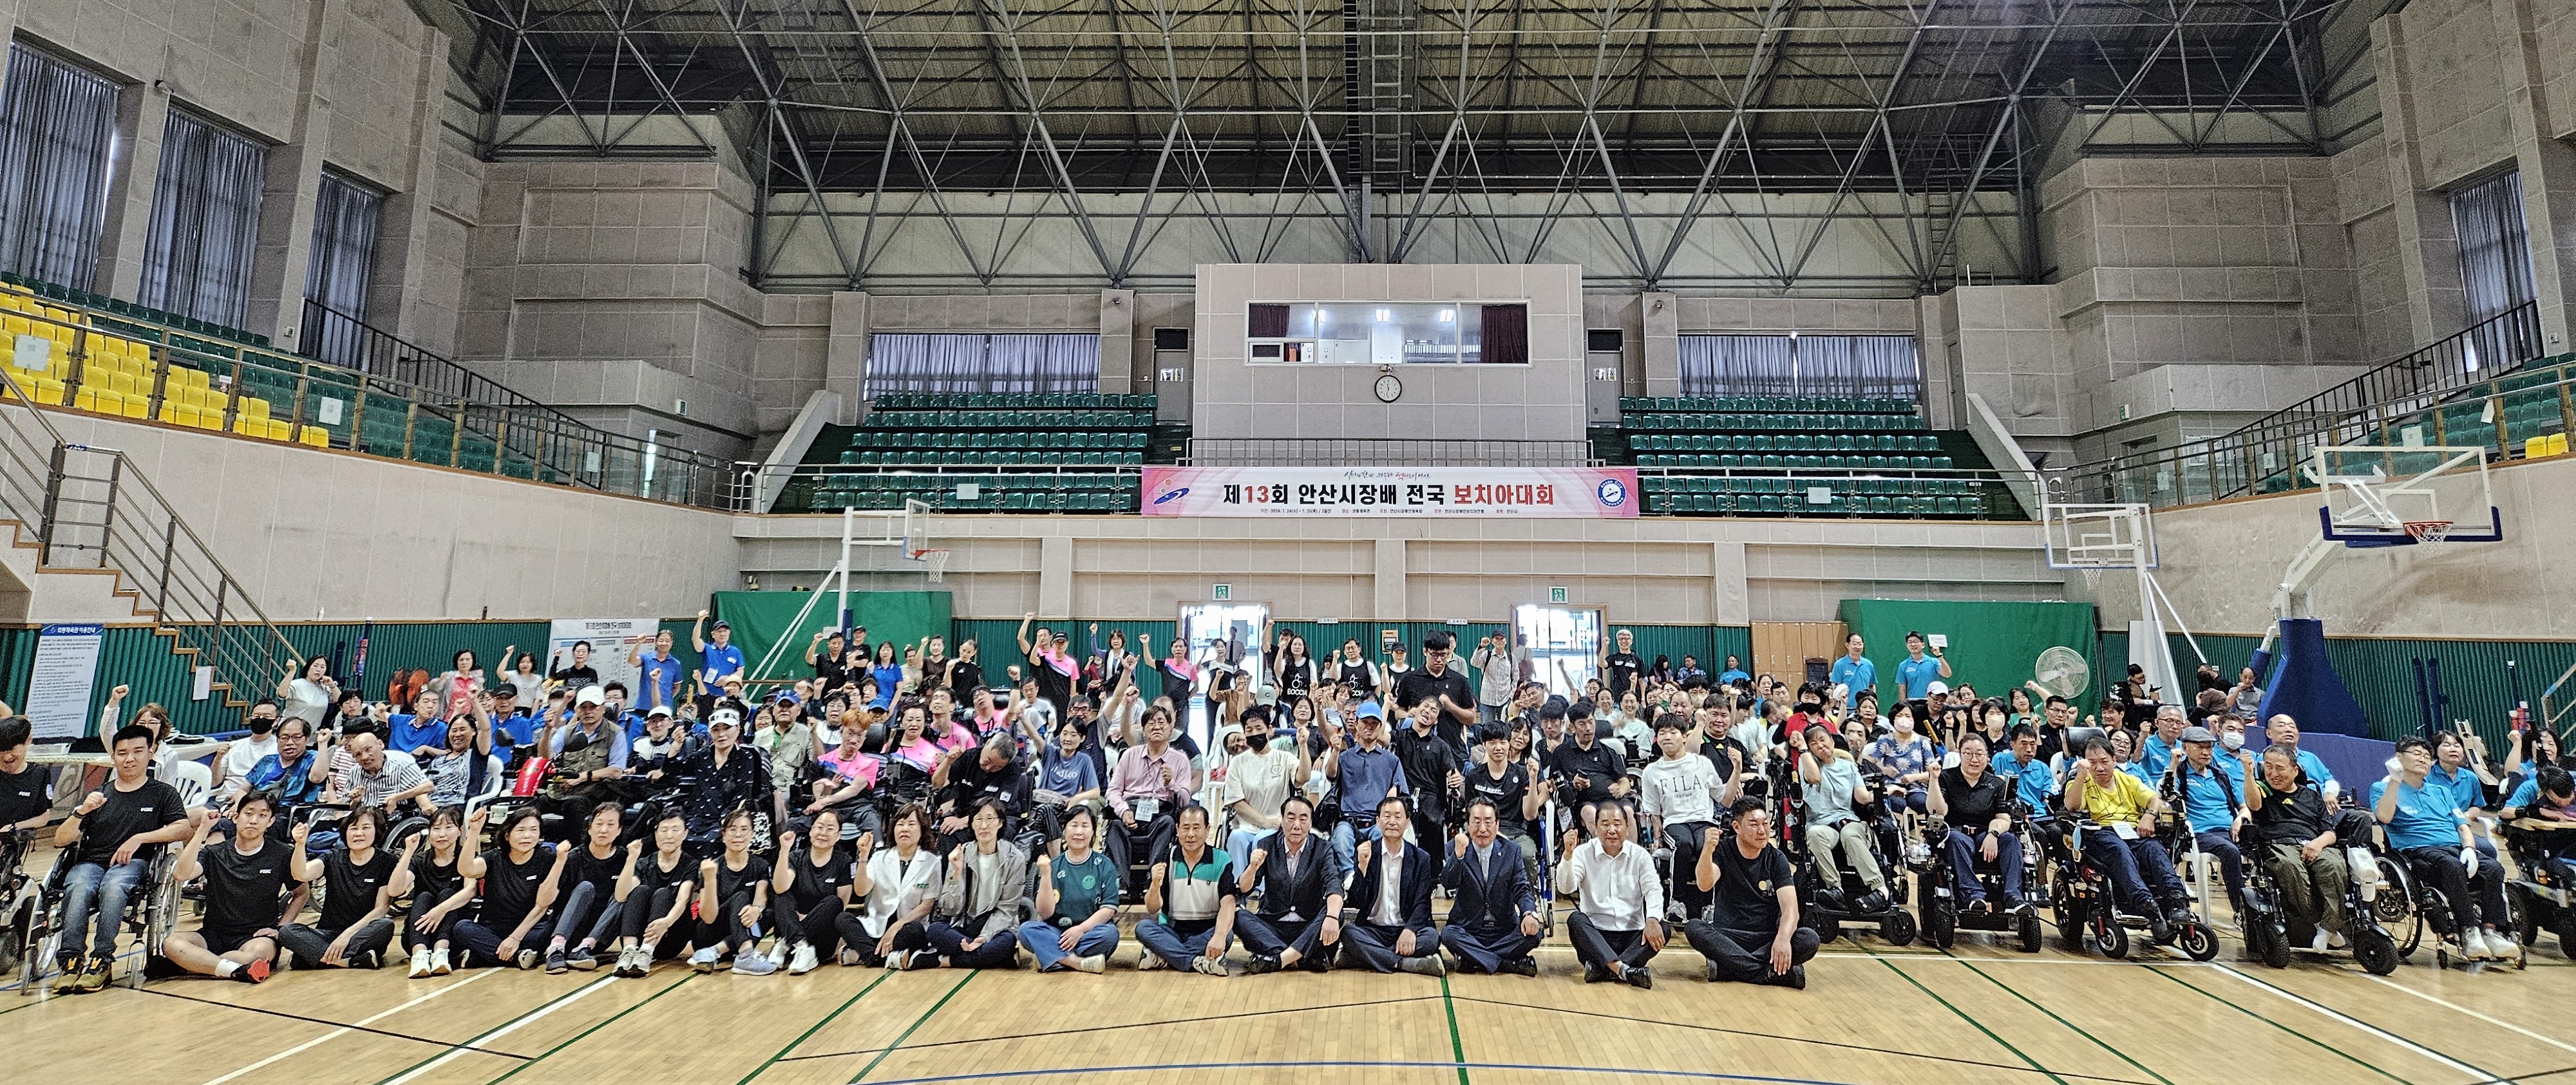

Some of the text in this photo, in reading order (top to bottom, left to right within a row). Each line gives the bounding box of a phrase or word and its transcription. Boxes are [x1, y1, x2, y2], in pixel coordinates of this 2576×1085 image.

[1224, 484, 1553, 505] 제13회 안산시장배 전국 보치아대회
[1287, 688, 1307, 696] BOCCIA
[1660, 774, 1702, 795] FILA
